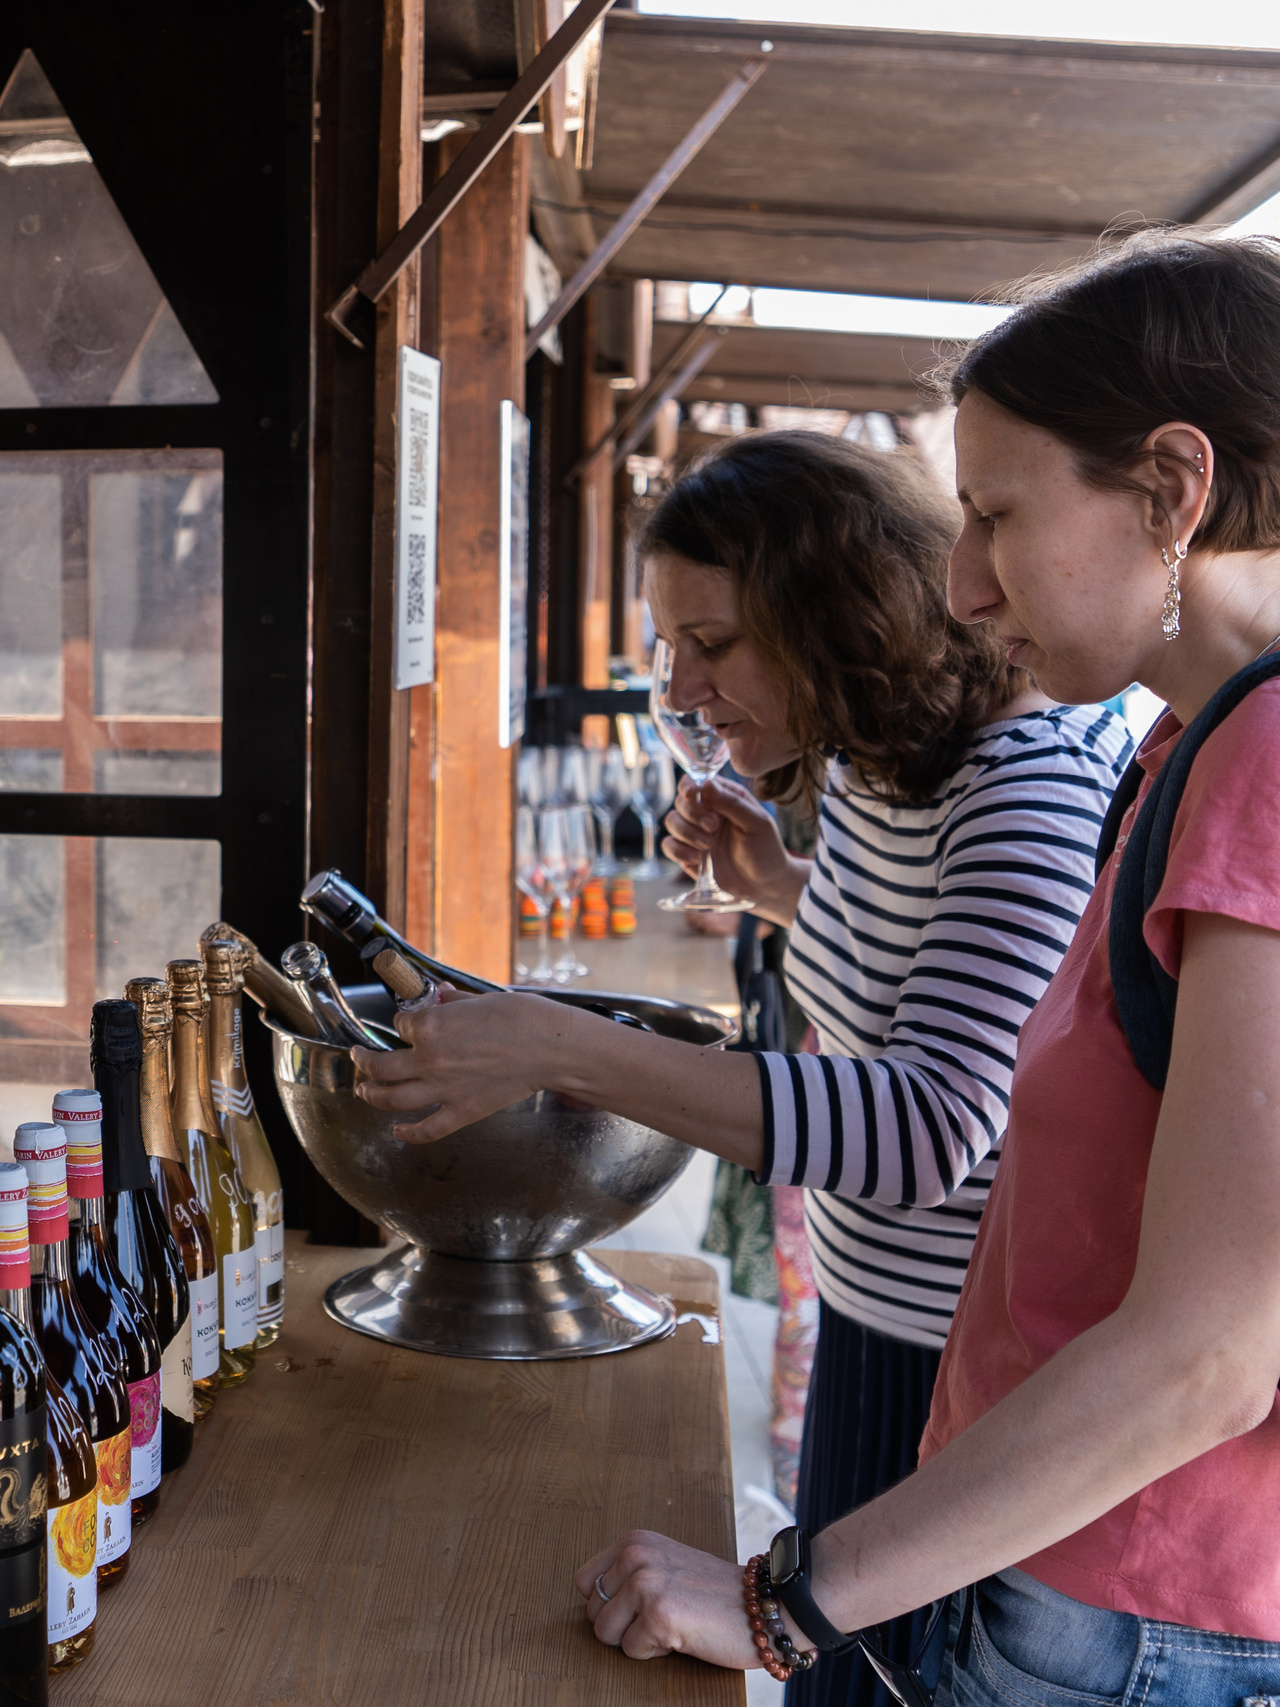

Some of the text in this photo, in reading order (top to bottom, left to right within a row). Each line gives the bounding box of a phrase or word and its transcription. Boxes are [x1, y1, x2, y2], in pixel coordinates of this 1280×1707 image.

[68, 1111, 98, 1120] VALERY
[15, 1148, 66, 1160] ARIN VALERY
